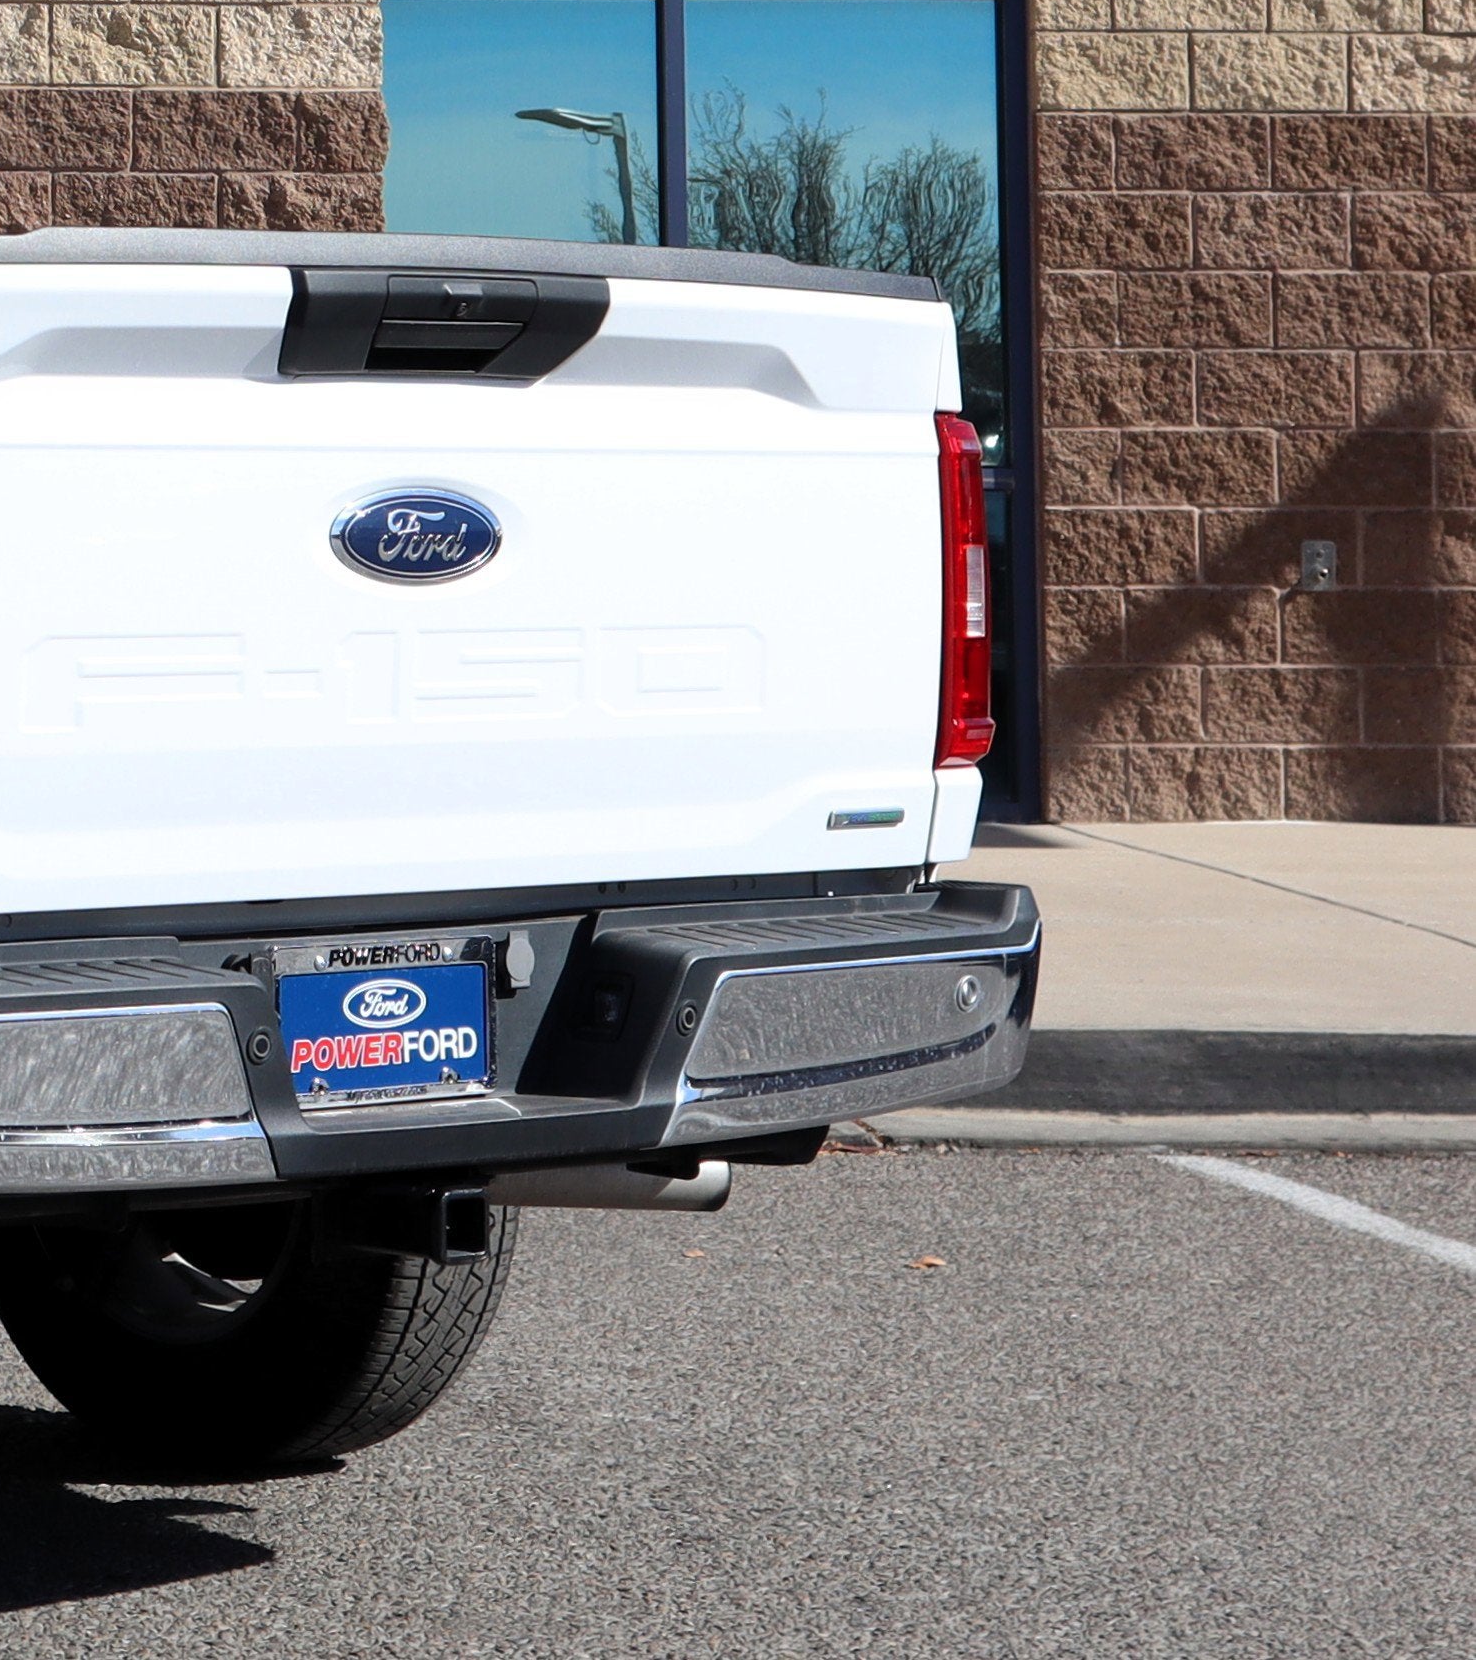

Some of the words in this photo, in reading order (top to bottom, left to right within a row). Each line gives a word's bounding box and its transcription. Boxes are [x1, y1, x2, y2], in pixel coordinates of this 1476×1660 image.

[377, 508, 467, 562] Ford
[19, 625, 766, 733] F-150
[329, 942, 441, 968] POWERFORD
[359, 988, 409, 1018] Ford
[290, 1026, 478, 1073] POWERFORD
